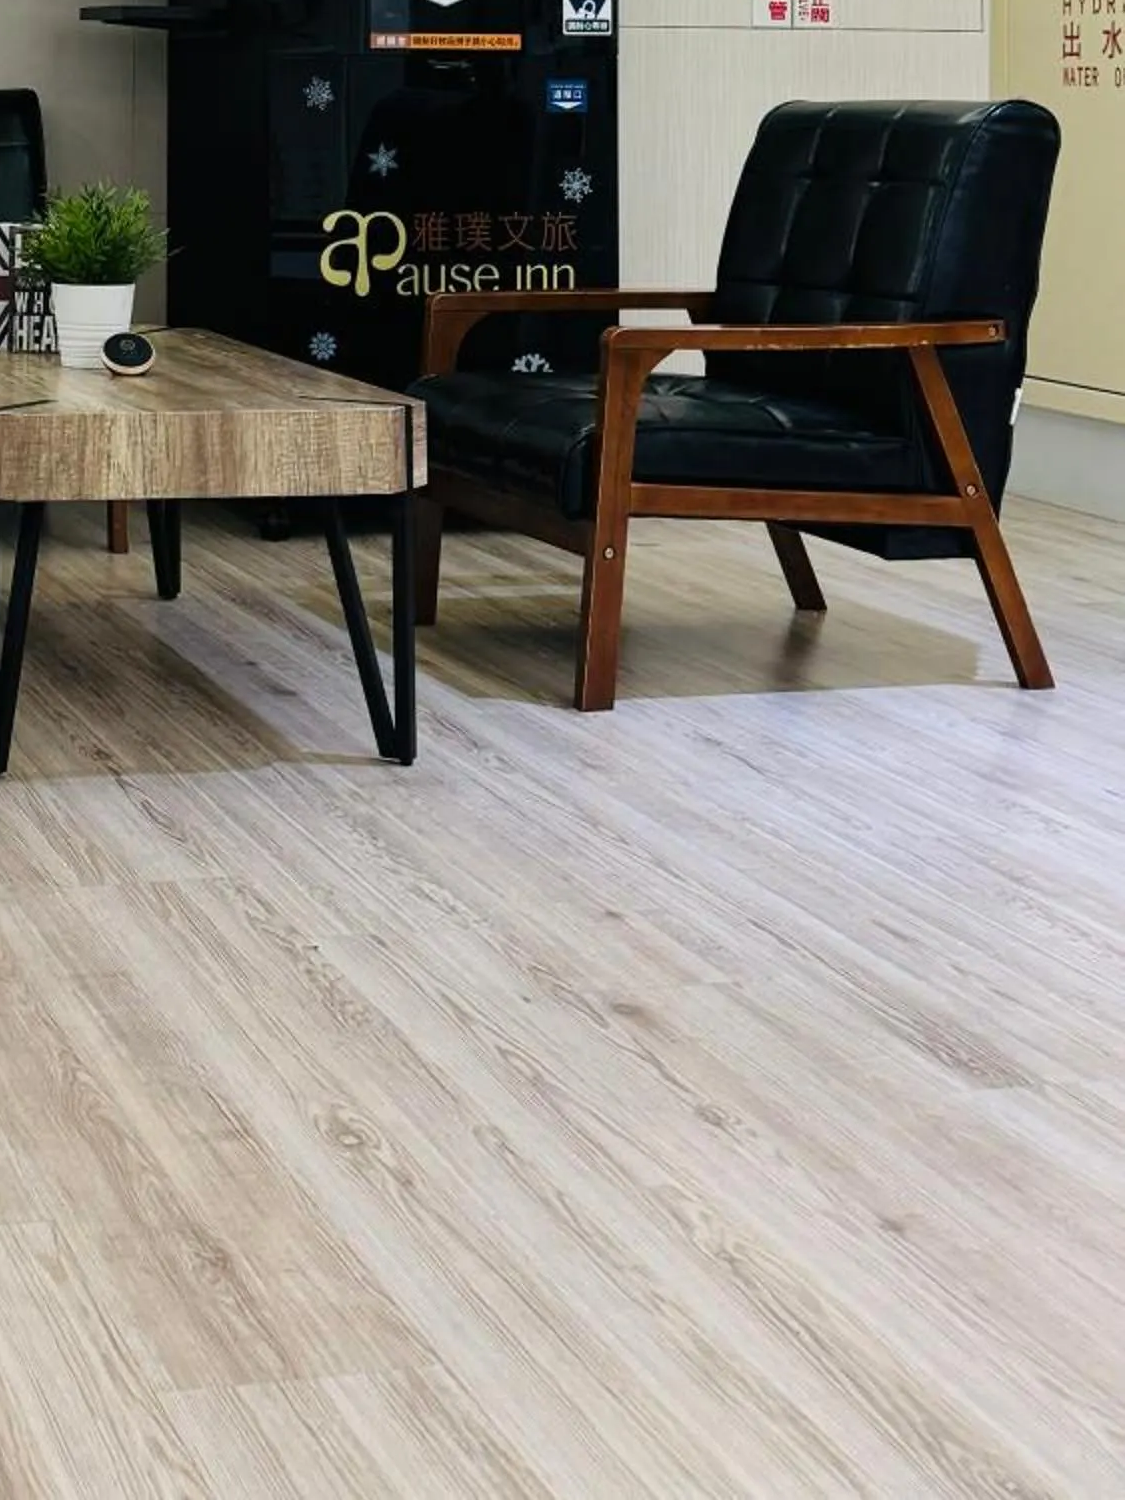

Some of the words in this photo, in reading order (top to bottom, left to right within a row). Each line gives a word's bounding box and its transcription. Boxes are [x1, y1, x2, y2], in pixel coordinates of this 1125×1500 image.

[1063, 66, 1100, 87] WATER
[1114, 66, 1125, 88] O
[412, 211, 578, 252] 雅璞文旅
[515, 263, 576, 292] inn
